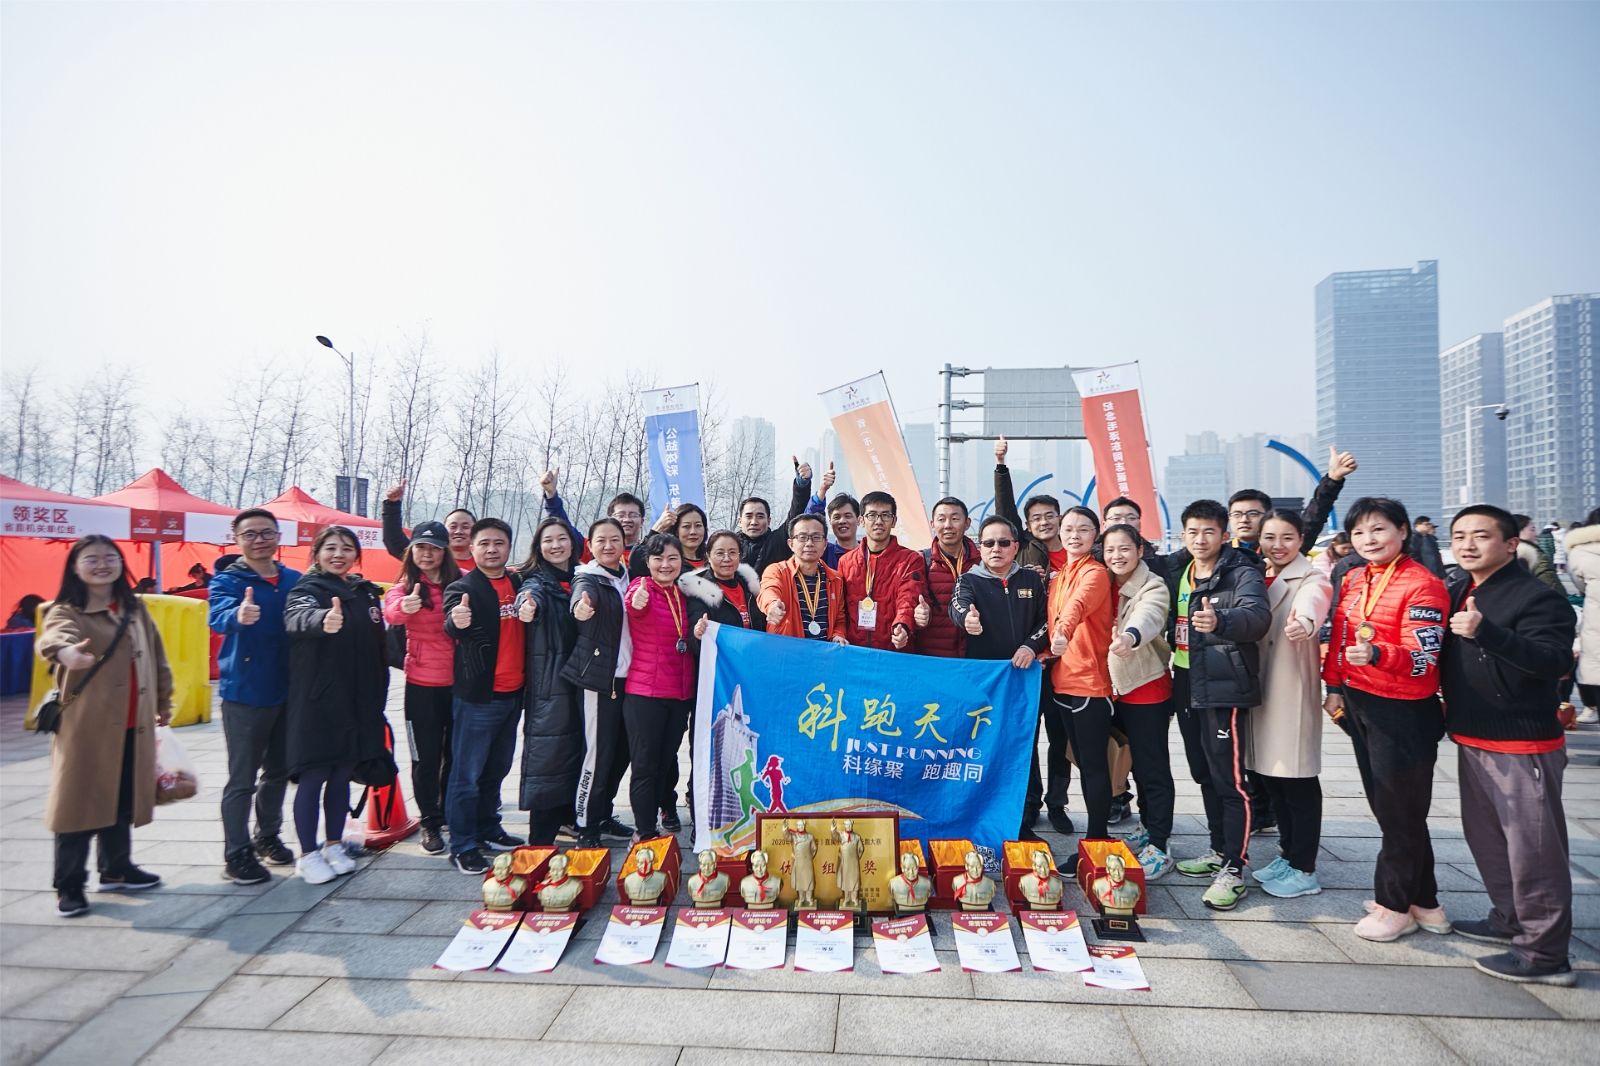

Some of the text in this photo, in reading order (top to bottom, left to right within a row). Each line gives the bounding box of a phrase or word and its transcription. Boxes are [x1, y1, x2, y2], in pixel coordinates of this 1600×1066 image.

[13, 505, 70, 524] 领奖区
[4, 523, 76, 535] 省直机关单位组
[798, 682, 993, 751] 科跑天下
[847, 738, 982, 760] JUST RUNNING
[842, 754, 984, 783] 科缘聚 跑趣同
[580, 769, 592, 790] Keep
